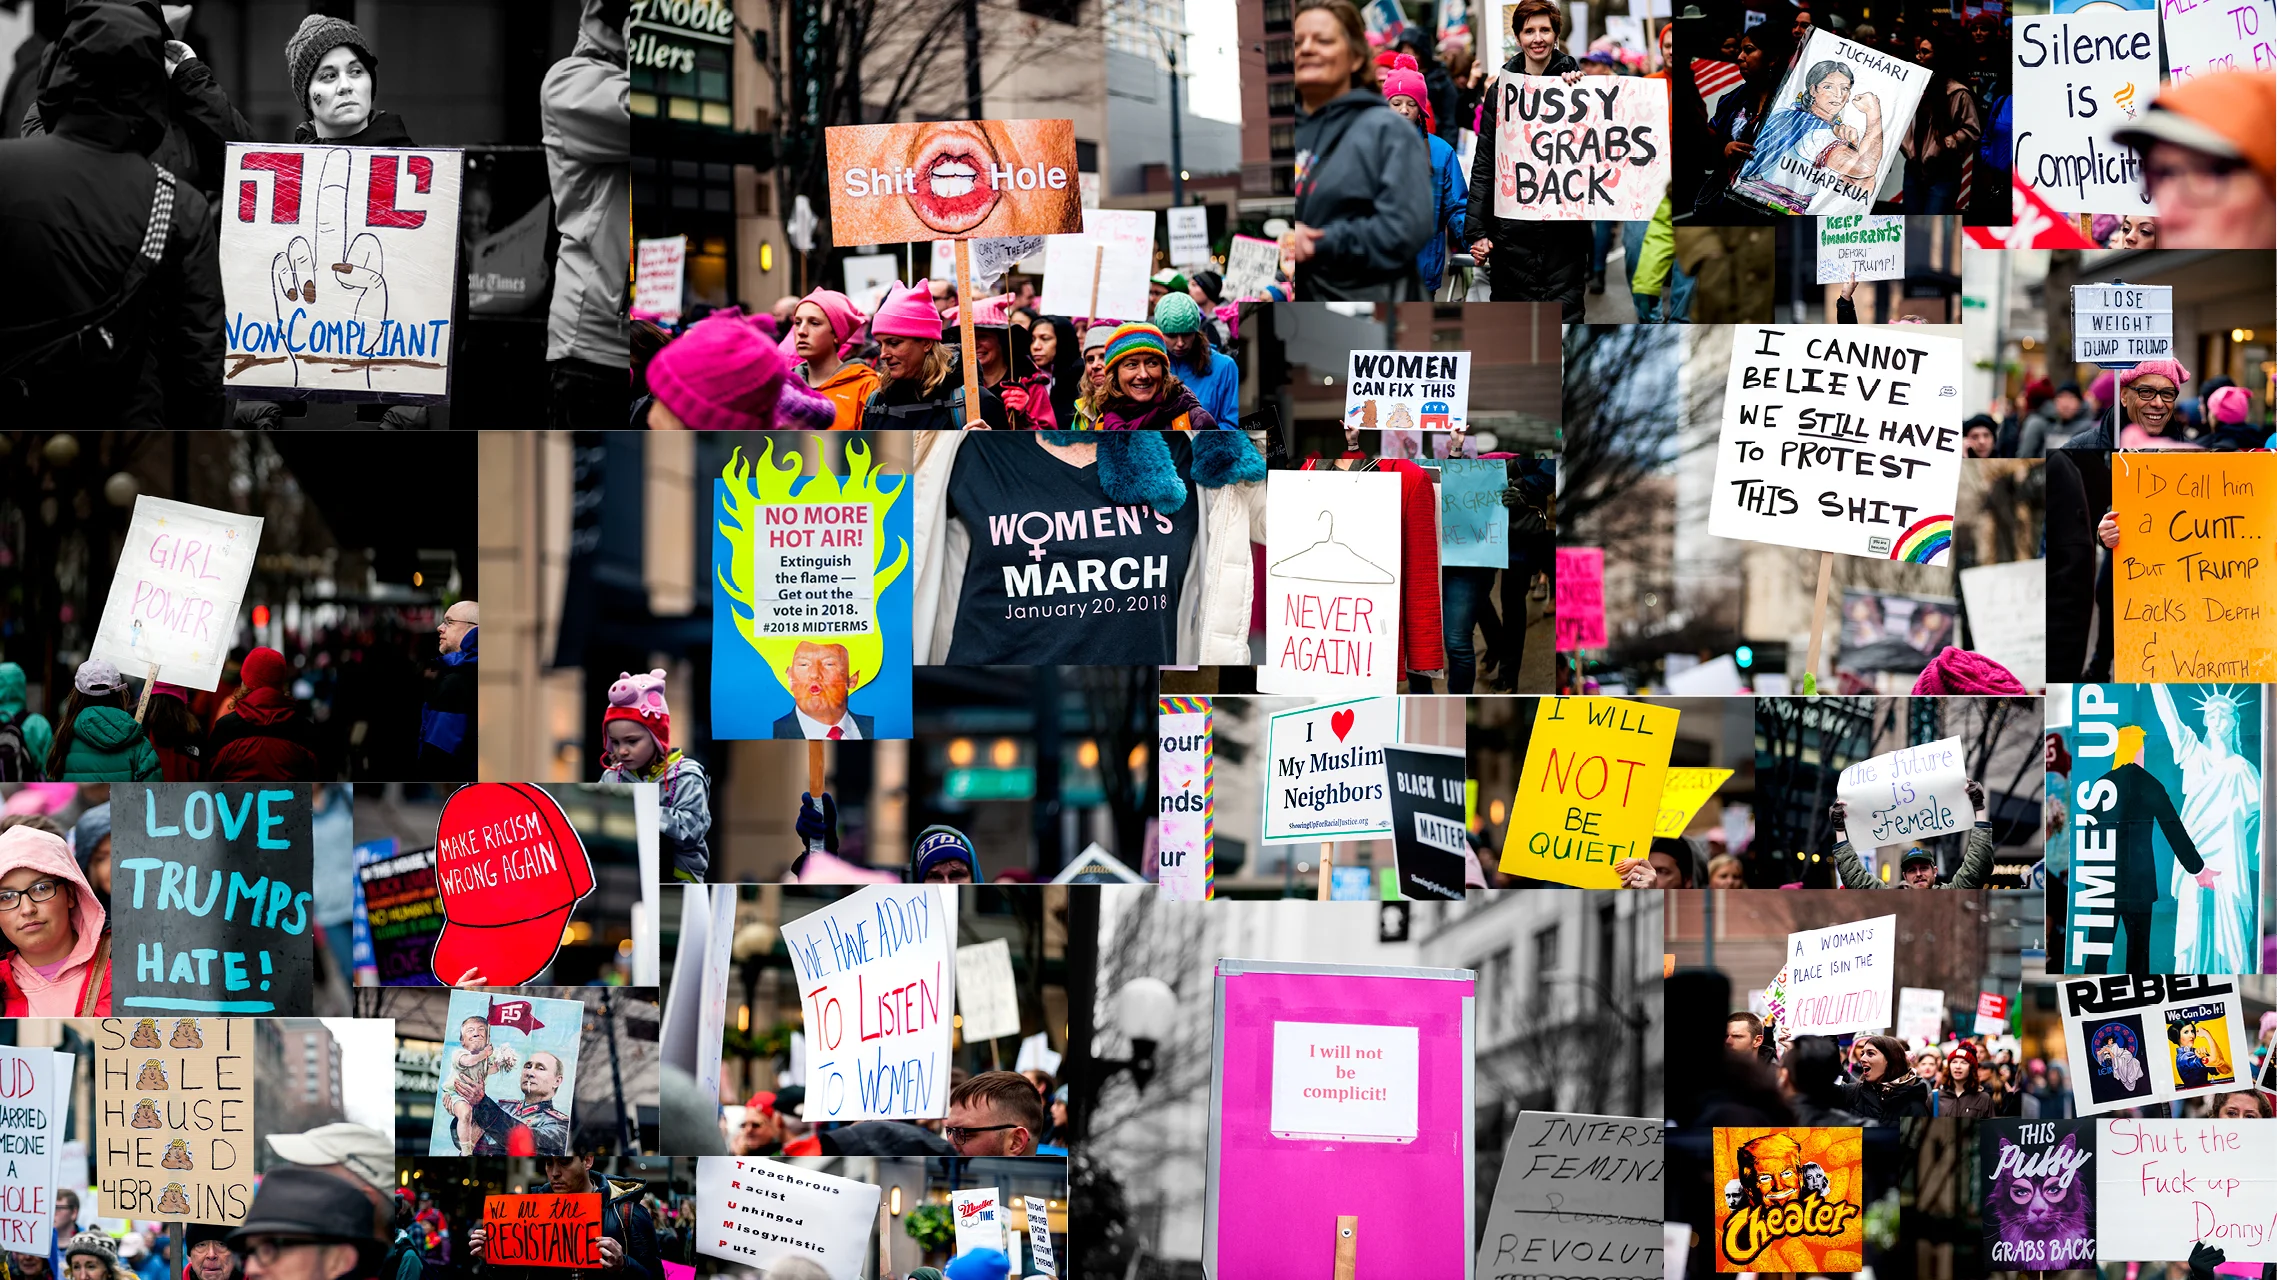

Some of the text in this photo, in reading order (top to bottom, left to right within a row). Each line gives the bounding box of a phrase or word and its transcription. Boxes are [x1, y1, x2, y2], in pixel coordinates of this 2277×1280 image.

[2227, 6, 2259, 40] TO
[2018, 23, 2150, 67] Silence
[1505, 83, 1619, 123] PUSSY
[2067, 83, 2097, 118] is
[1531, 126, 1657, 166] GRABS
[844, 163, 1067, 197] Shit Hole
[1516, 162, 1614, 205] BACK
[1827, 215, 1863, 230] KEEP
[1852, 255, 1894, 272] TRUMP!
[2104, 291, 2143, 308] LOSE
[2092, 316, 2152, 331] WEIGHT
[1755, 329, 1928, 375] I CANNOT
[2084, 339, 2168, 357] DUMP TRUMP
[1354, 354, 1458, 380] WOMEN
[1353, 381, 1456, 398] CAN FIX THIS
[1743, 367, 1911, 406] BELIEVE
[1740, 404, 1959, 453] WE STILL HAVE
[1781, 441, 1931, 480] PROTEST
[1731, 479, 1799, 516] THIS
[2223, 470, 2254, 497] him
[765, 506, 868, 525] NO MORE
[2138, 513, 2153, 534] a
[770, 529, 862, 547] HOT AIR!
[150, 534, 221, 580] GIRL
[780, 555, 851, 569] Extinguish
[775, 572, 838, 584] the flame
[1002, 555, 1168, 598] MARCH
[131, 580, 214, 642] POWER
[773, 604, 858, 616] vote in 2018.
[778, 588, 853, 600] Get out the
[1005, 594, 1167, 619] January 20, 2018
[763, 621, 868, 632] #2018 MIDTERMS
[1285, 594, 1373, 633] NEVER
[1281, 636, 1372, 677] AGAIN!
[1306, 722, 1313, 742] I
[1548, 697, 1653, 735] I WILL
[2078, 683, 2119, 758] UP
[1278, 745, 1384, 779] My Muslim
[1541, 748, 1646, 807] NOT
[1284, 781, 1383, 811] Neighbors
[1397, 772, 1435, 799] BLACK
[1892, 781, 1916, 806] is
[146, 788, 294, 850] LOVE
[1564, 807, 1602, 836] BE
[1872, 795, 1955, 840] Female
[440, 811, 542, 862] MAKE RACISM
[1529, 832, 1635, 865] QUIET!
[440, 841, 557, 896] WRONG AGAIN
[2072, 778, 2118, 966] TIME'S
[119, 857, 313, 936] TRUMPS
[791, 934, 831, 981] WE
[823, 915, 874, 972] HAVE
[1795, 928, 1874, 957] A WOMAN'S
[137, 942, 273, 991] HATE!
[1793, 964, 1822, 985] PLACE
[1855, 953, 1873, 969] THE
[807, 985, 842, 1051] TO
[859, 961, 940, 1042] LISTEN
[1792, 989, 1887, 1029] REVOLUTION
[2066, 974, 2233, 1017] REBEL
[2166, 1003, 2224, 1021] We Can Do It!
[1310, 1044, 1383, 1059] I will not
[818, 1046, 934, 1118] TO WOMEN
[1336, 1065, 1355, 1079] be
[1303, 1086, 1387, 1103] complicit!
[2018, 1122, 2056, 1145] THIS
[2109, 1118, 2241, 1155] Shut the
[7, 1160, 18, 1179] A
[2141, 1160, 2240, 1198] Fuck up
[518, 1201, 539, 1218] are
[549, 1197, 586, 1219] the
[979, 1211, 994, 1221] TIME
[2188, 1200, 2277, 1247] Donny!
[1724, 1191, 1858, 1262] Cheater
[1991, 1238, 2096, 1262] GRABS BACK
